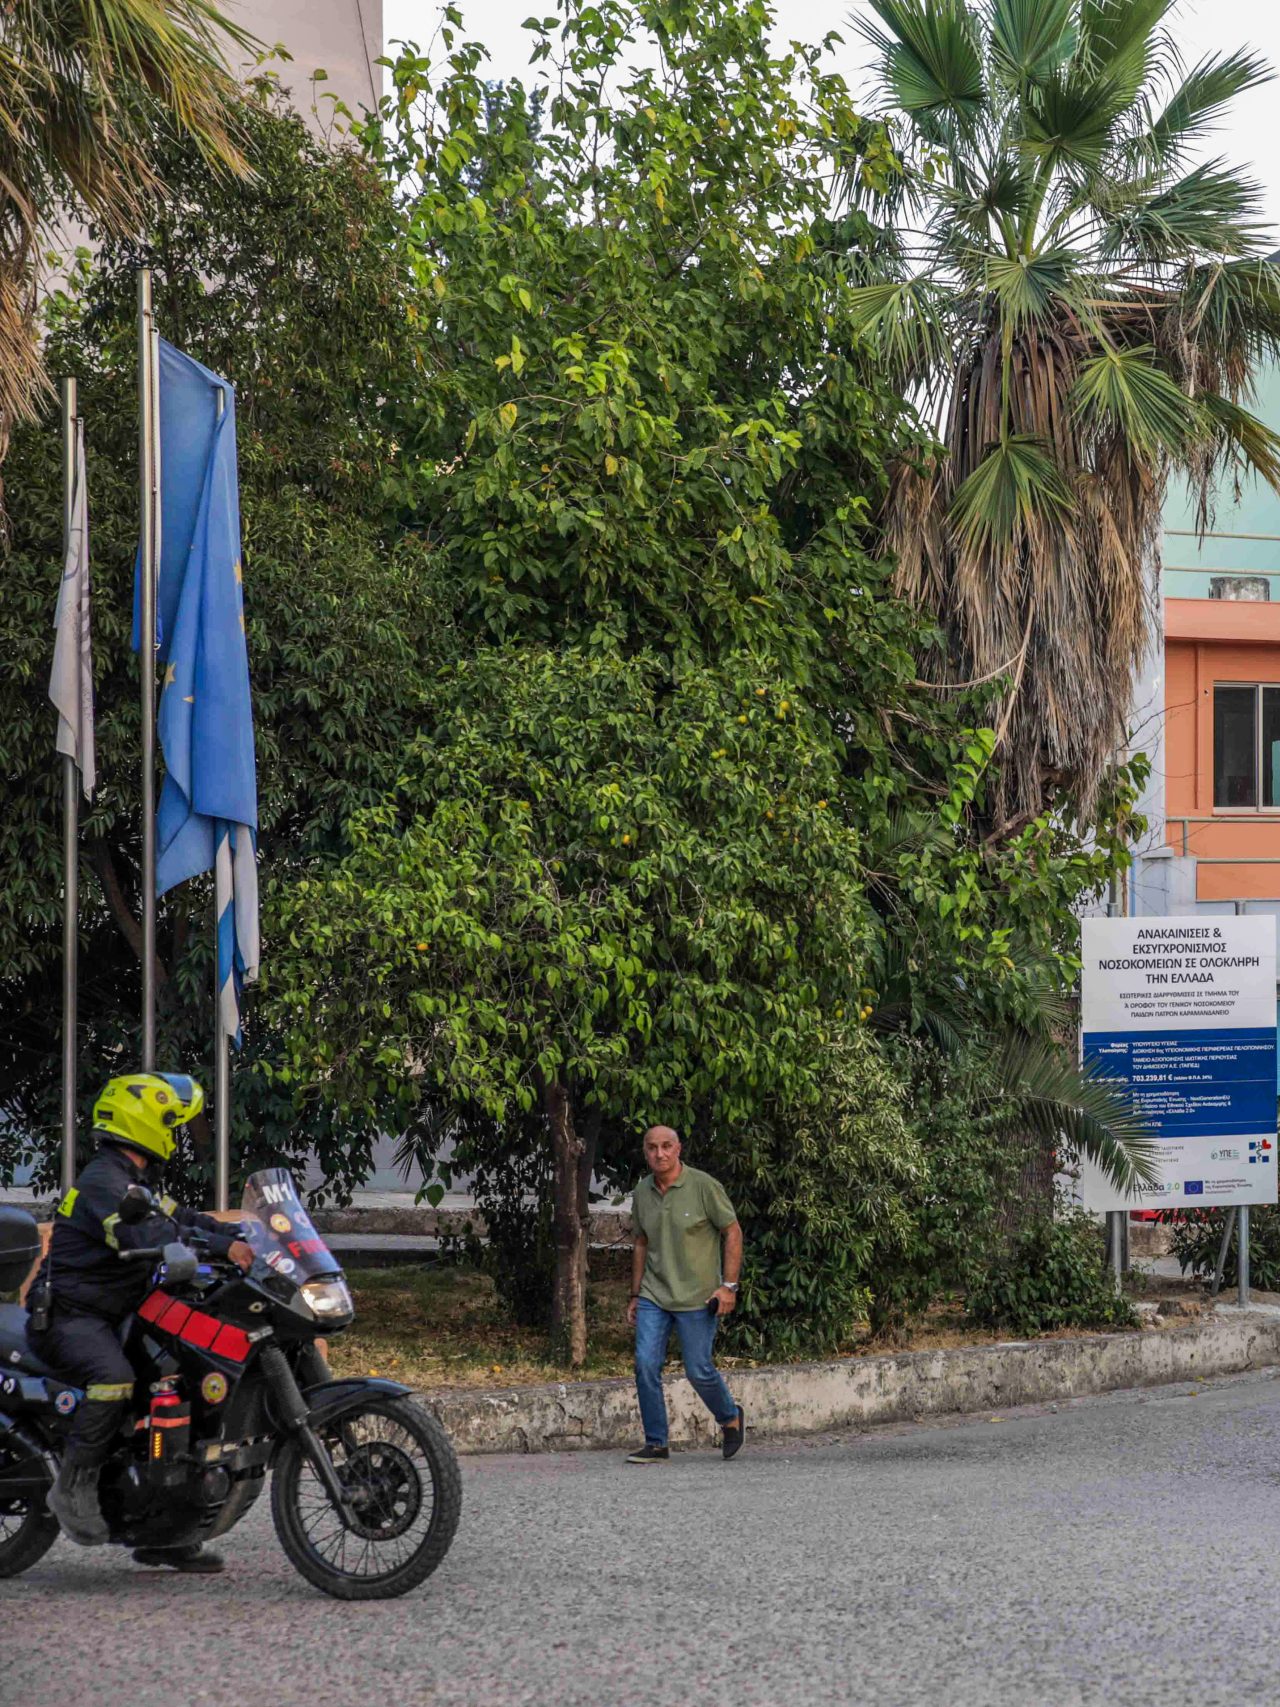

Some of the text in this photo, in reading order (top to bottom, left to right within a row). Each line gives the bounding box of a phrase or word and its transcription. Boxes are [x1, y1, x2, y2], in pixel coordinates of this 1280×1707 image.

[1137, 927, 1222, 939] ΑΝΑΚΑΙΝΙΣΕΙΣ &
[1132, 942, 1227, 954] ΕΚΣΥΓΧΡΟΝΙΣΜΟΣ
[1099, 956, 1260, 970] ΝΟΣΟΚΟΜΕΙΩΝ ΣΕ ΟΛΟΚΛΗΡΗ
[1146, 972, 1214, 984] ΤΗΝ ΕΛΛΑΔΑ
[262, 1183, 293, 1204] M1
